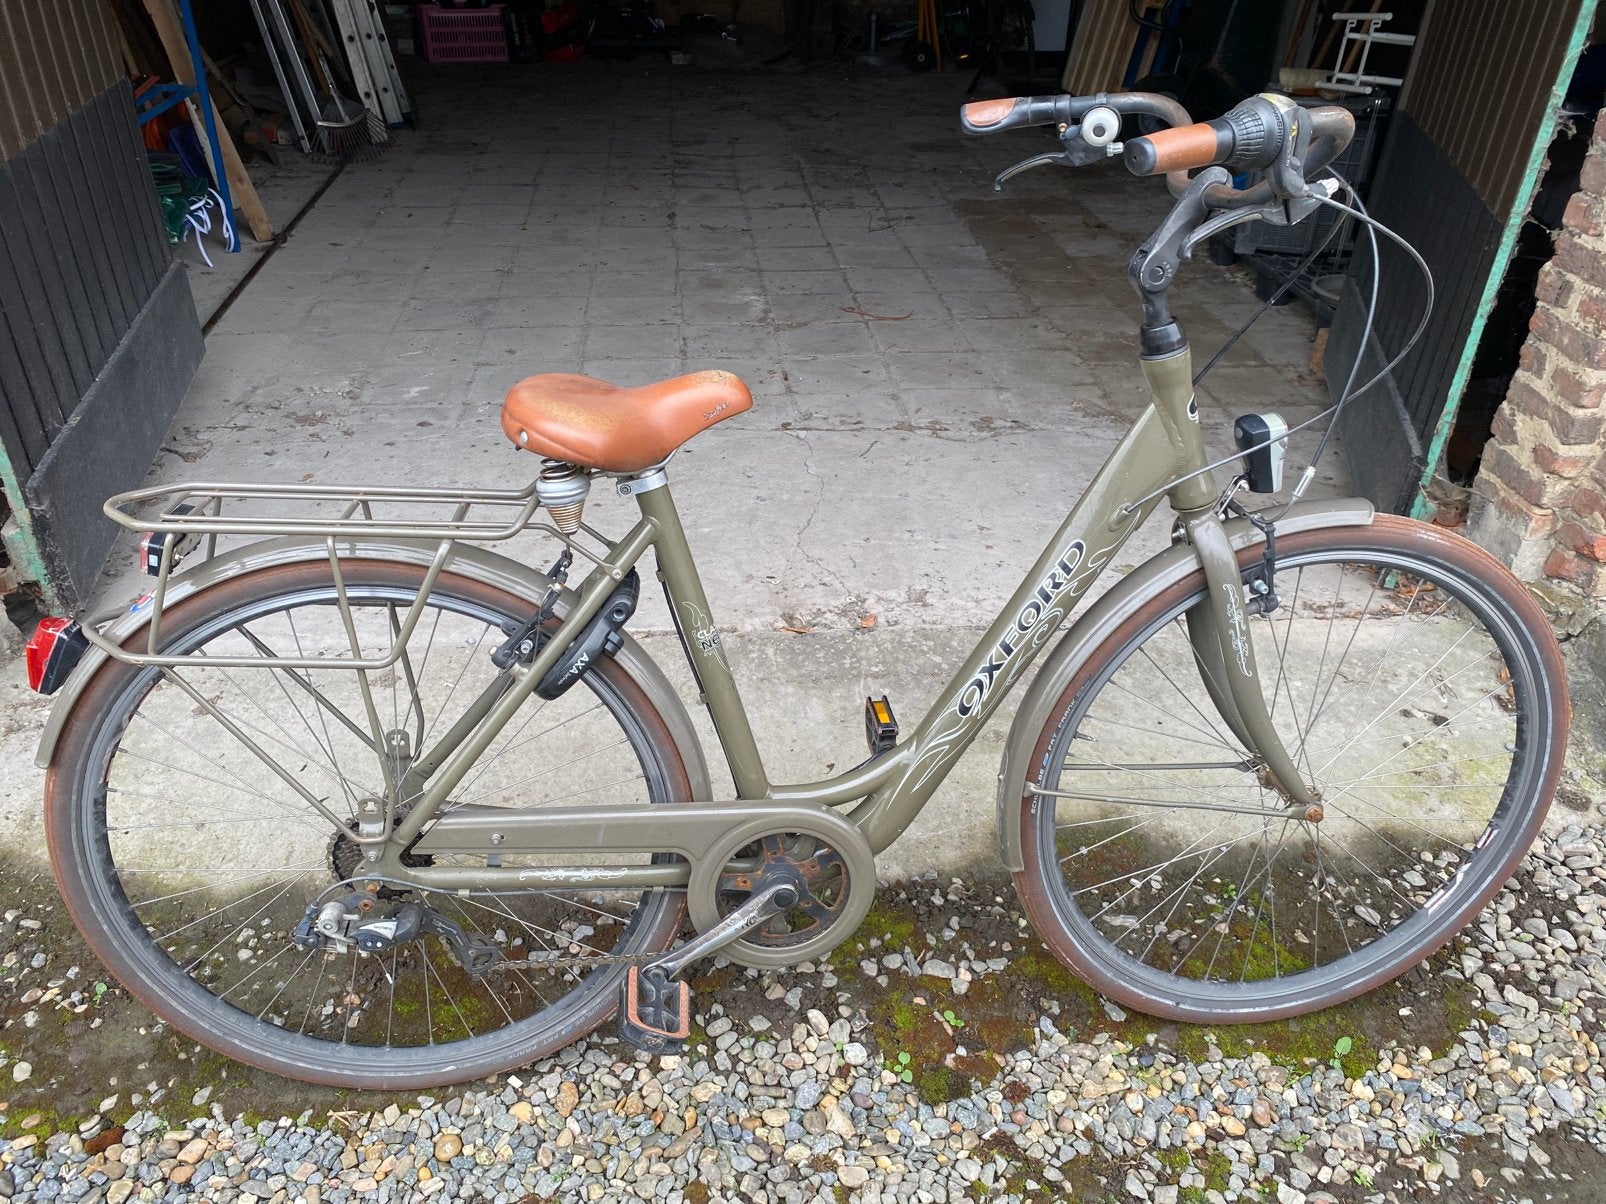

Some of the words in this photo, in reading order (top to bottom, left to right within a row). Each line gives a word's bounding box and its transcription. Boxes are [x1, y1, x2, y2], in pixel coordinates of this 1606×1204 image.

[569, 652, 589, 674] AXA
[957, 539, 1086, 717] OXFORD
[1031, 768, 1045, 816] SCHLBE
[1047, 733, 1058, 751] FAT
